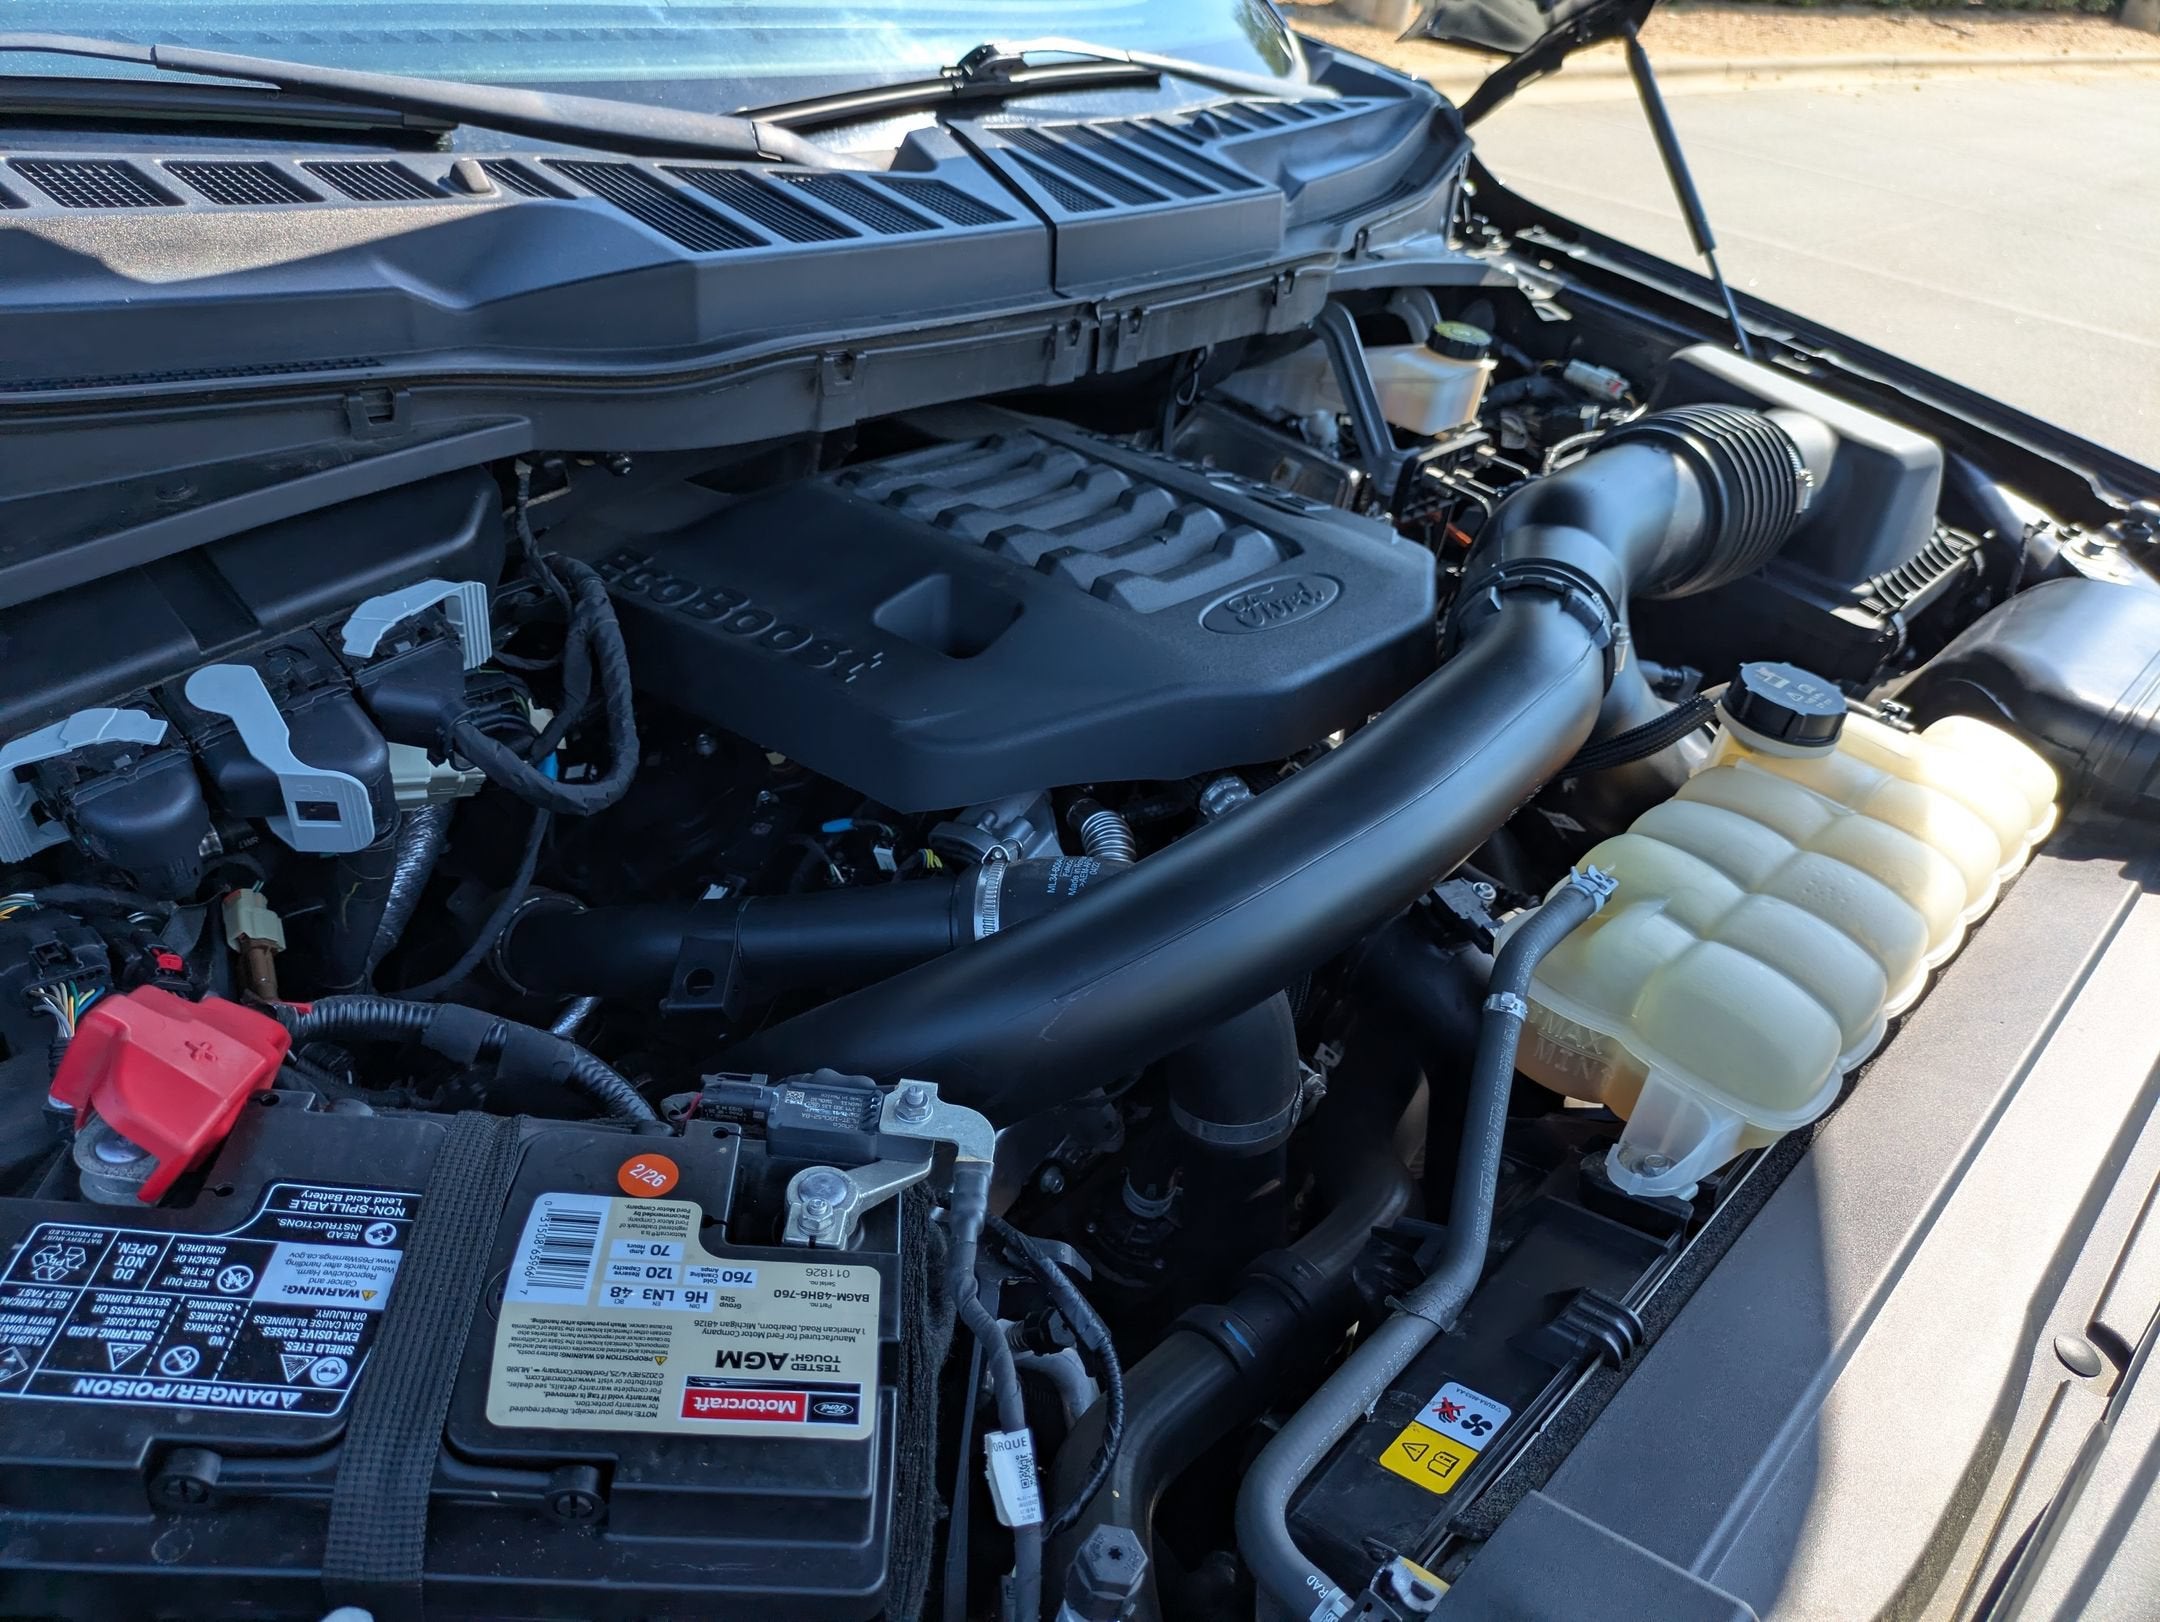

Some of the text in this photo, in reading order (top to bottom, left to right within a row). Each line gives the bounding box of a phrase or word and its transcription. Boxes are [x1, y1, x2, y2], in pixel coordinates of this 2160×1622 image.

[1225, 581, 1325, 629] Ford
[1541, 1012, 1608, 1055] MAX
[629, 1163, 667, 1188] 2/26
[300, 1189, 402, 1206] Lead Acid Battery
[288, 1198, 405, 1216] NON-SPILLABLE
[641, 1211, 690, 1220] Recommended
[277, 1217, 362, 1231] INSTRUCTIONS.
[533, 1215, 550, 1246] 31508
[65, 1236, 102, 1244] BATTERY
[326, 1230, 359, 1240] READ
[117, 1241, 158, 1256] OPEN.
[177, 1242, 226, 1254] CHILDREN.
[649, 1243, 670, 1256] 70
[50, 1257, 65, 1266] Pb
[113, 1254, 146, 1268] NOT
[172, 1254, 221, 1265] REACH OF
[288, 1251, 396, 1265] www.P65Warnings.ca.gov
[523, 1248, 539, 1278] 65966
[179, 1265, 215, 1276] OF THE
[284, 1257, 395, 1273] Wash hands after handling.
[612, 1264, 641, 1272] Capacity
[112, 1267, 135, 1280] DO
[295, 1268, 377, 1280] Reproductive Harm.
[645, 1266, 672, 1279] 120
[721, 1270, 752, 1283] 760
[805, 1267, 850, 1278] 011826
[160, 1276, 210, 1288] KEEP OUT
[308, 1276, 357, 1287] Cancer and
[16, 1287, 73, 1300] HELP FAST.
[281, 1284, 360, 1298] WARNING:
[609, 1285, 708, 1303] H6 LN3 48
[773, 1288, 869, 1302] BAGM-48H6-760
[0, 1296, 67, 1309] GET MEDICAL
[95, 1292, 172, 1306] SEVERE BURNS.
[186, 1299, 234, 1311] SMOKING
[718, 1301, 742, 1309] Group
[91, 1304, 166, 1317] BLINDNESS OR
[187, 1310, 228, 1322] FLAMES
[315, 1309, 367, 1321] OR INJURY.
[27, 1315, 56, 1326] WITH
[102, 1316, 160, 1328] CAN CAUSE
[182, 1321, 223, 1333] SPARKS
[252, 1314, 363, 1330] CAN CAUSE BLINDNESS
[693, 1319, 865, 1335] 1 American Road, Dearborn, Michigan 48126
[0, 1323, 52, 1335] IMMEDIAT
[66, 1325, 154, 1341] SULFURIC ACID
[299, 1328, 360, 1342] EXPLOSIVE
[701, 1327, 856, 1343] Manufactured for Ford Motor Company
[8, 1334, 46, 1345] FLUSH
[207, 1335, 225, 1346] NO
[283, 1340, 355, 1355] SHIELD EYES.
[714, 1349, 789, 1371] AGM
[790, 1362, 840, 1372] TESTED
[72, 1378, 279, 1405] DANGER/POISON
[586, 1391, 600, 1399] tag
[624, 1393, 660, 1402] Warranty
[540, 1406, 568, 1415] Receipt
[614, 1400, 647, 1408] warranty
[647, 1402, 659, 1410] for
[693, 1396, 796, 1414] Motorcraft
[819, 1403, 847, 1415] Ford
[569, 1407, 597, 1415] receipt.
[614, 1409, 633, 1417] Keep
[633, 1410, 657, 1418] NOTE:
[1306, 1574, 1329, 1599] RAD
